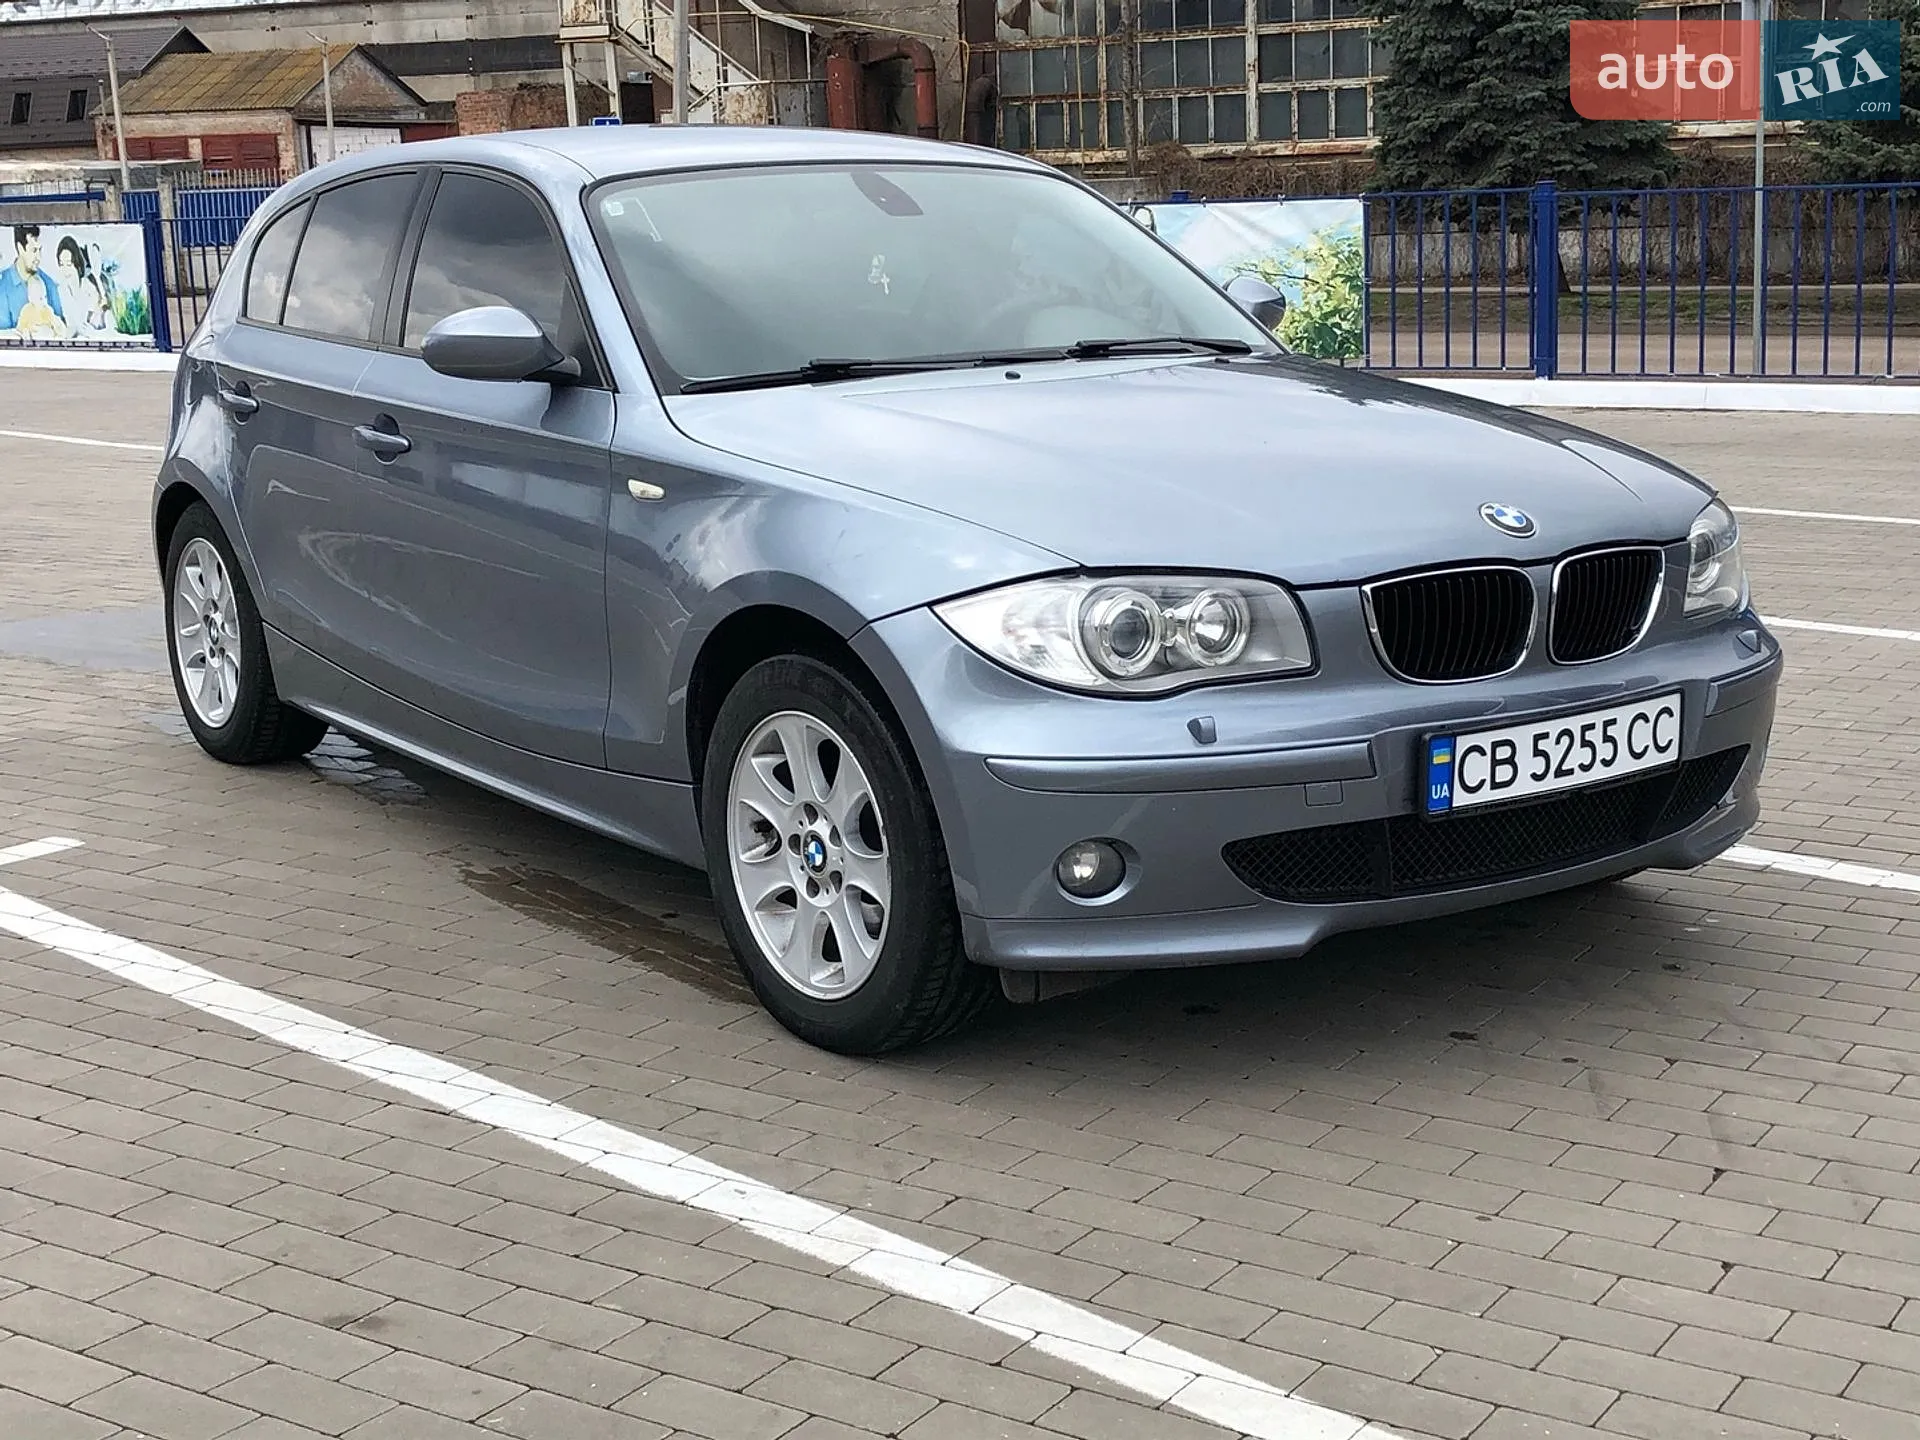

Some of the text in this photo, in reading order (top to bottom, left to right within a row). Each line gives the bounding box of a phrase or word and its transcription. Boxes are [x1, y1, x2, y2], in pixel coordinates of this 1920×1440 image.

[1457, 706, 1675, 795] CB 5255 CC
[1431, 783, 1450, 799] UA
